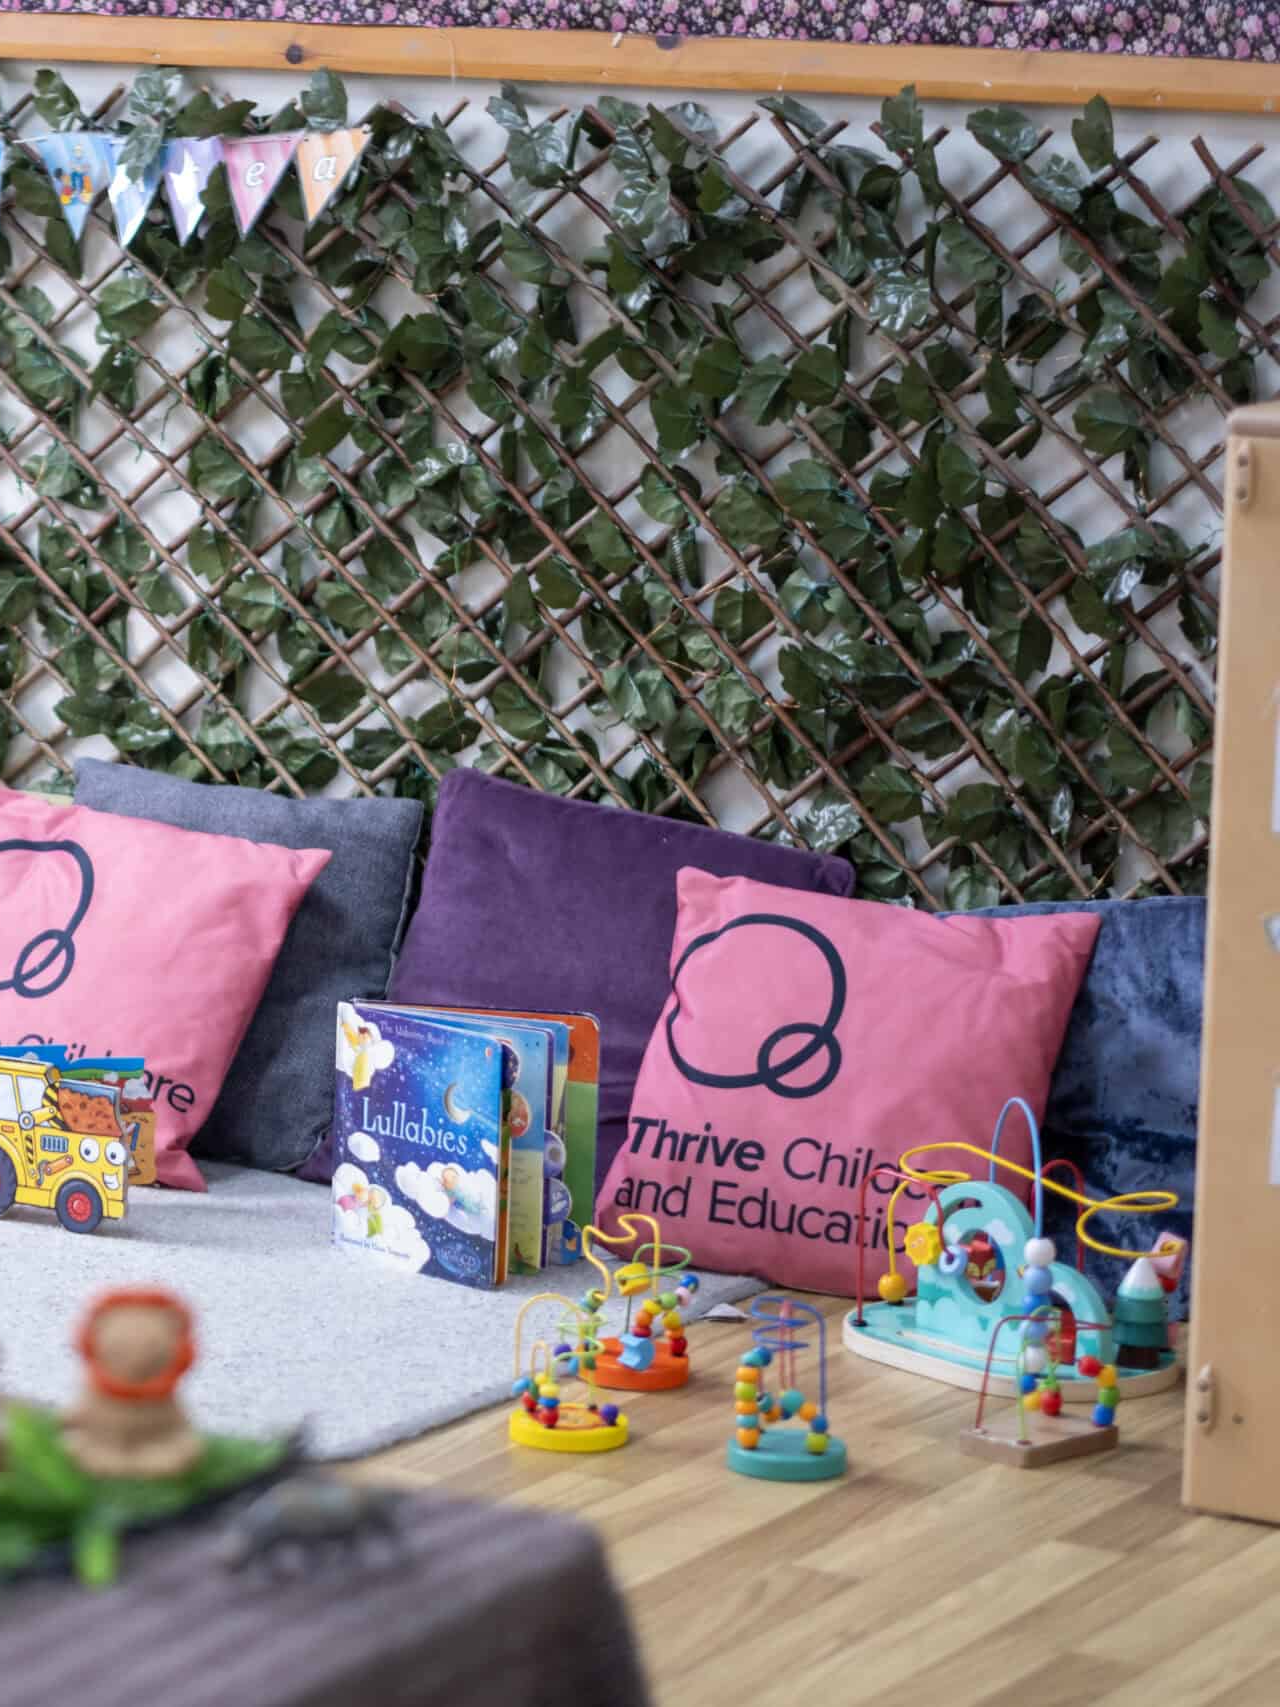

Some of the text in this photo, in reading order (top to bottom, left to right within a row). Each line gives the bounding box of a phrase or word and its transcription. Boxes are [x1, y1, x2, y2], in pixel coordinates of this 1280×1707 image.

[362, 1097, 469, 1156] Lullabies
[628, 1117, 766, 1172] Thrive
[614, 1175, 908, 1254] and Educatio
